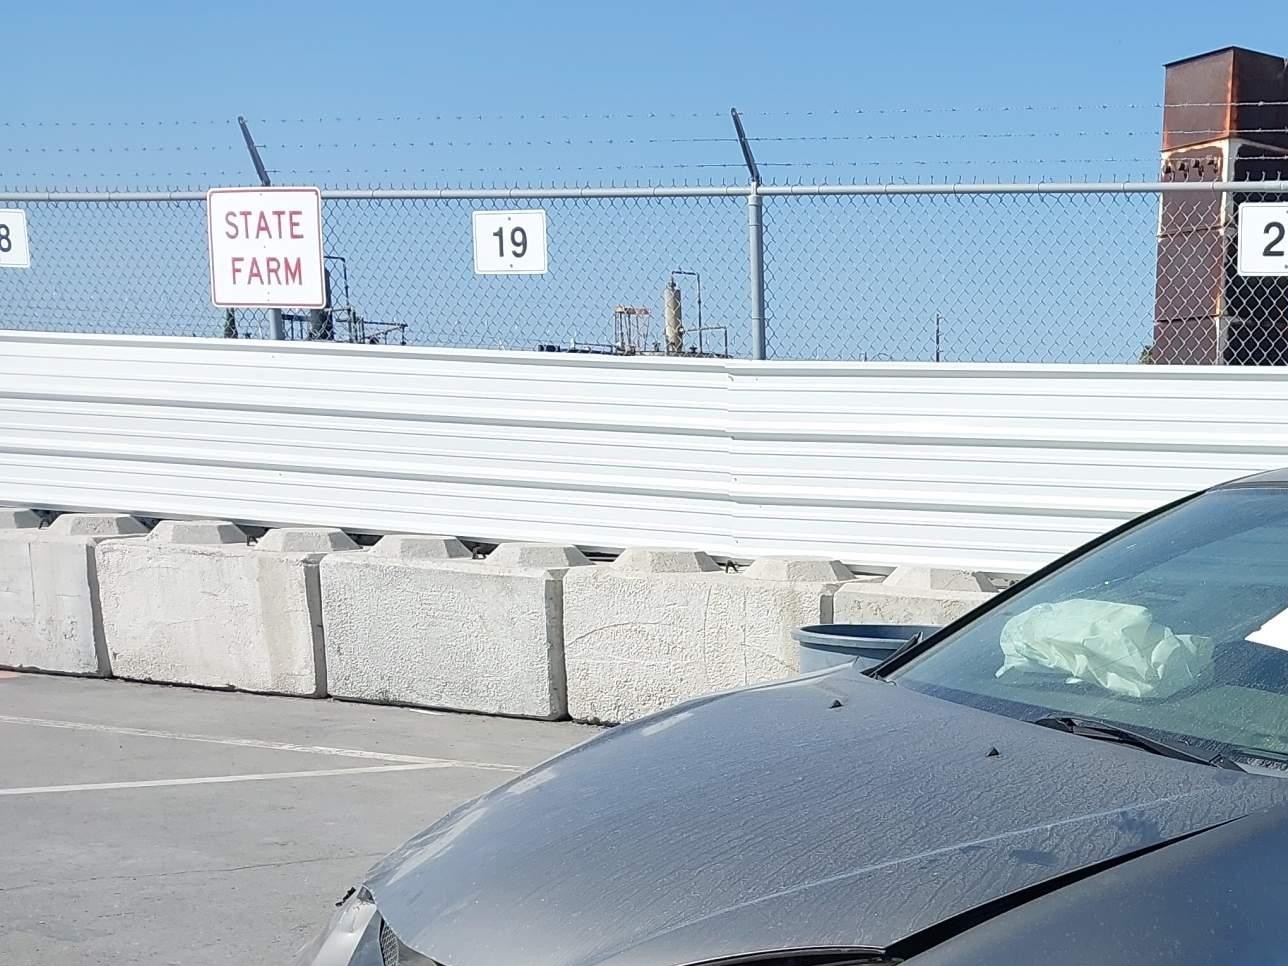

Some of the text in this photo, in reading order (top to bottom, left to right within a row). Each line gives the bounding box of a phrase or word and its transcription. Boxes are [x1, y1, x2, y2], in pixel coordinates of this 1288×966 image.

[224, 210, 305, 241] STATE
[491, 226, 529, 259] 19
[231, 256, 304, 287] FARM
